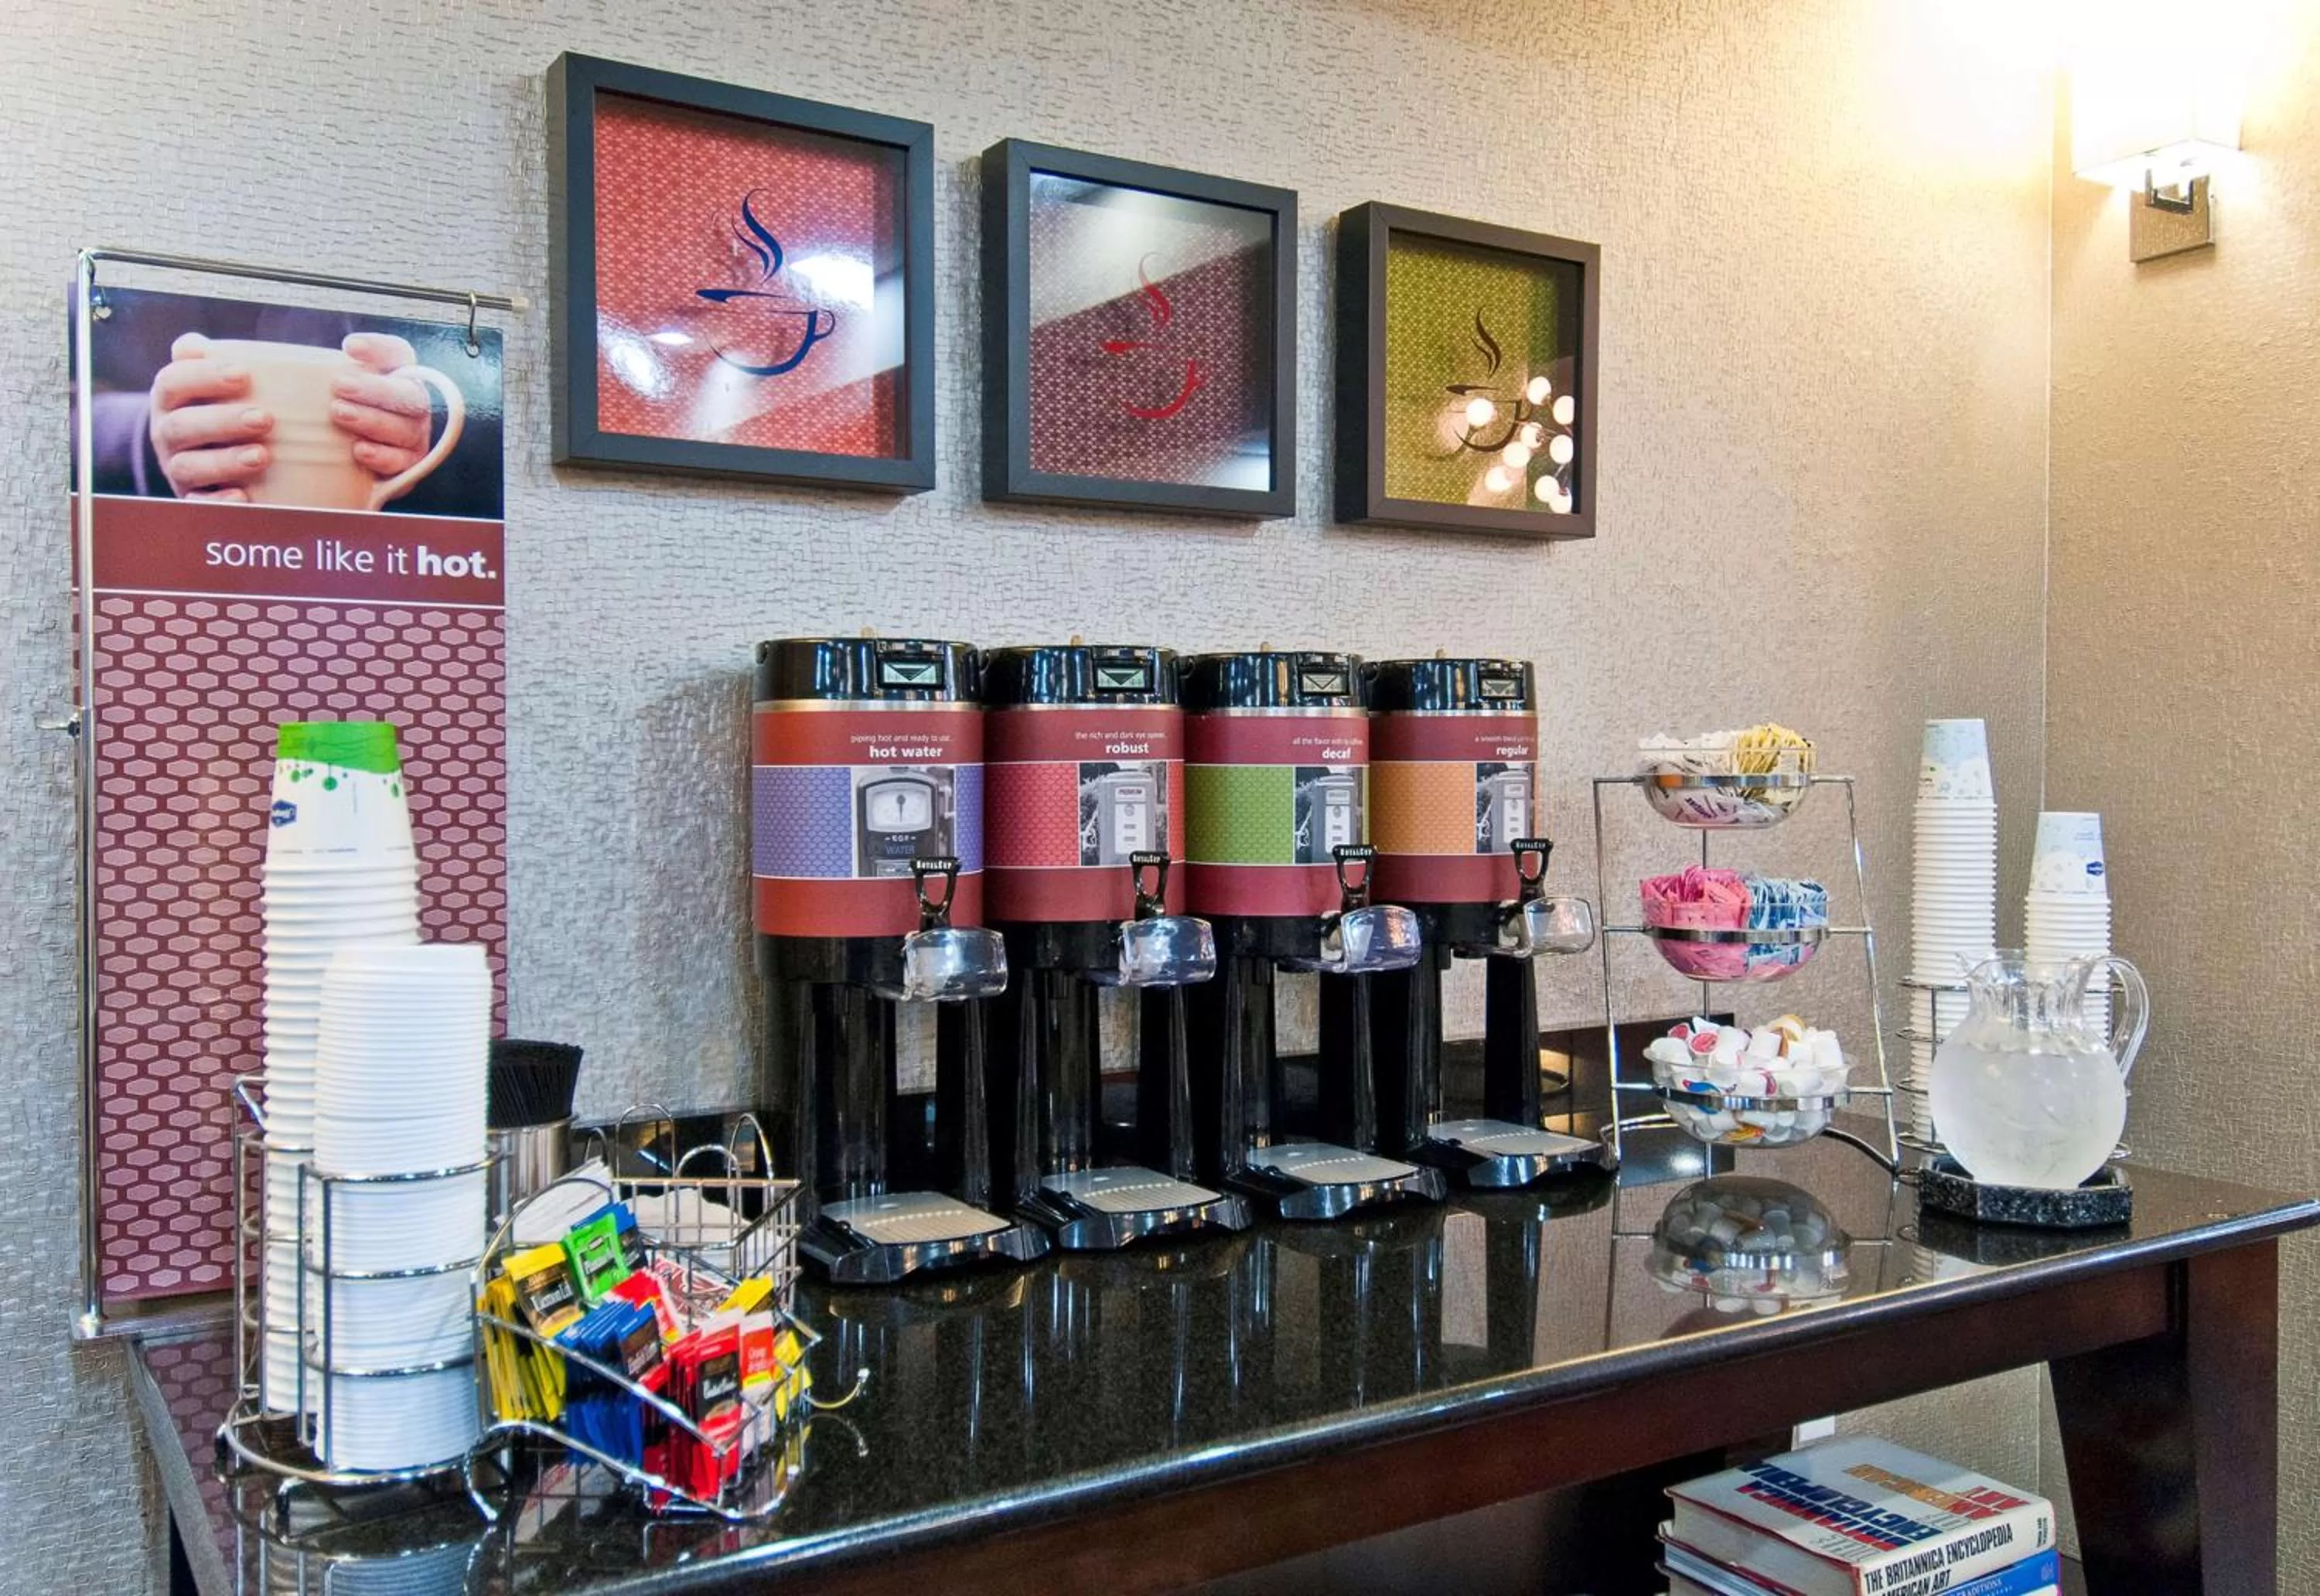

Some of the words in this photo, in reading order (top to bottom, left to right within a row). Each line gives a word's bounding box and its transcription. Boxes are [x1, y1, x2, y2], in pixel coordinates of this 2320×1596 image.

[204, 541, 303, 569] some
[316, 540, 375, 573] like
[387, 544, 409, 575] it
[417, 544, 497, 579] hot.
[868, 745, 898, 758] hot
[901, 746, 943, 758] water
[1104, 741, 1150, 754] robust
[1322, 747, 1351, 759] decaf
[1496, 743, 1530, 758] regular
[1864, 1569, 1884, 1594] THE
[1885, 1547, 1946, 1586] BRITANNICA
[1944, 1523, 2014, 1564] ENCYCLOPEDIA
[1882, 1575, 1931, 1596] MERICAN
[1932, 1569, 1951, 1591] ART
